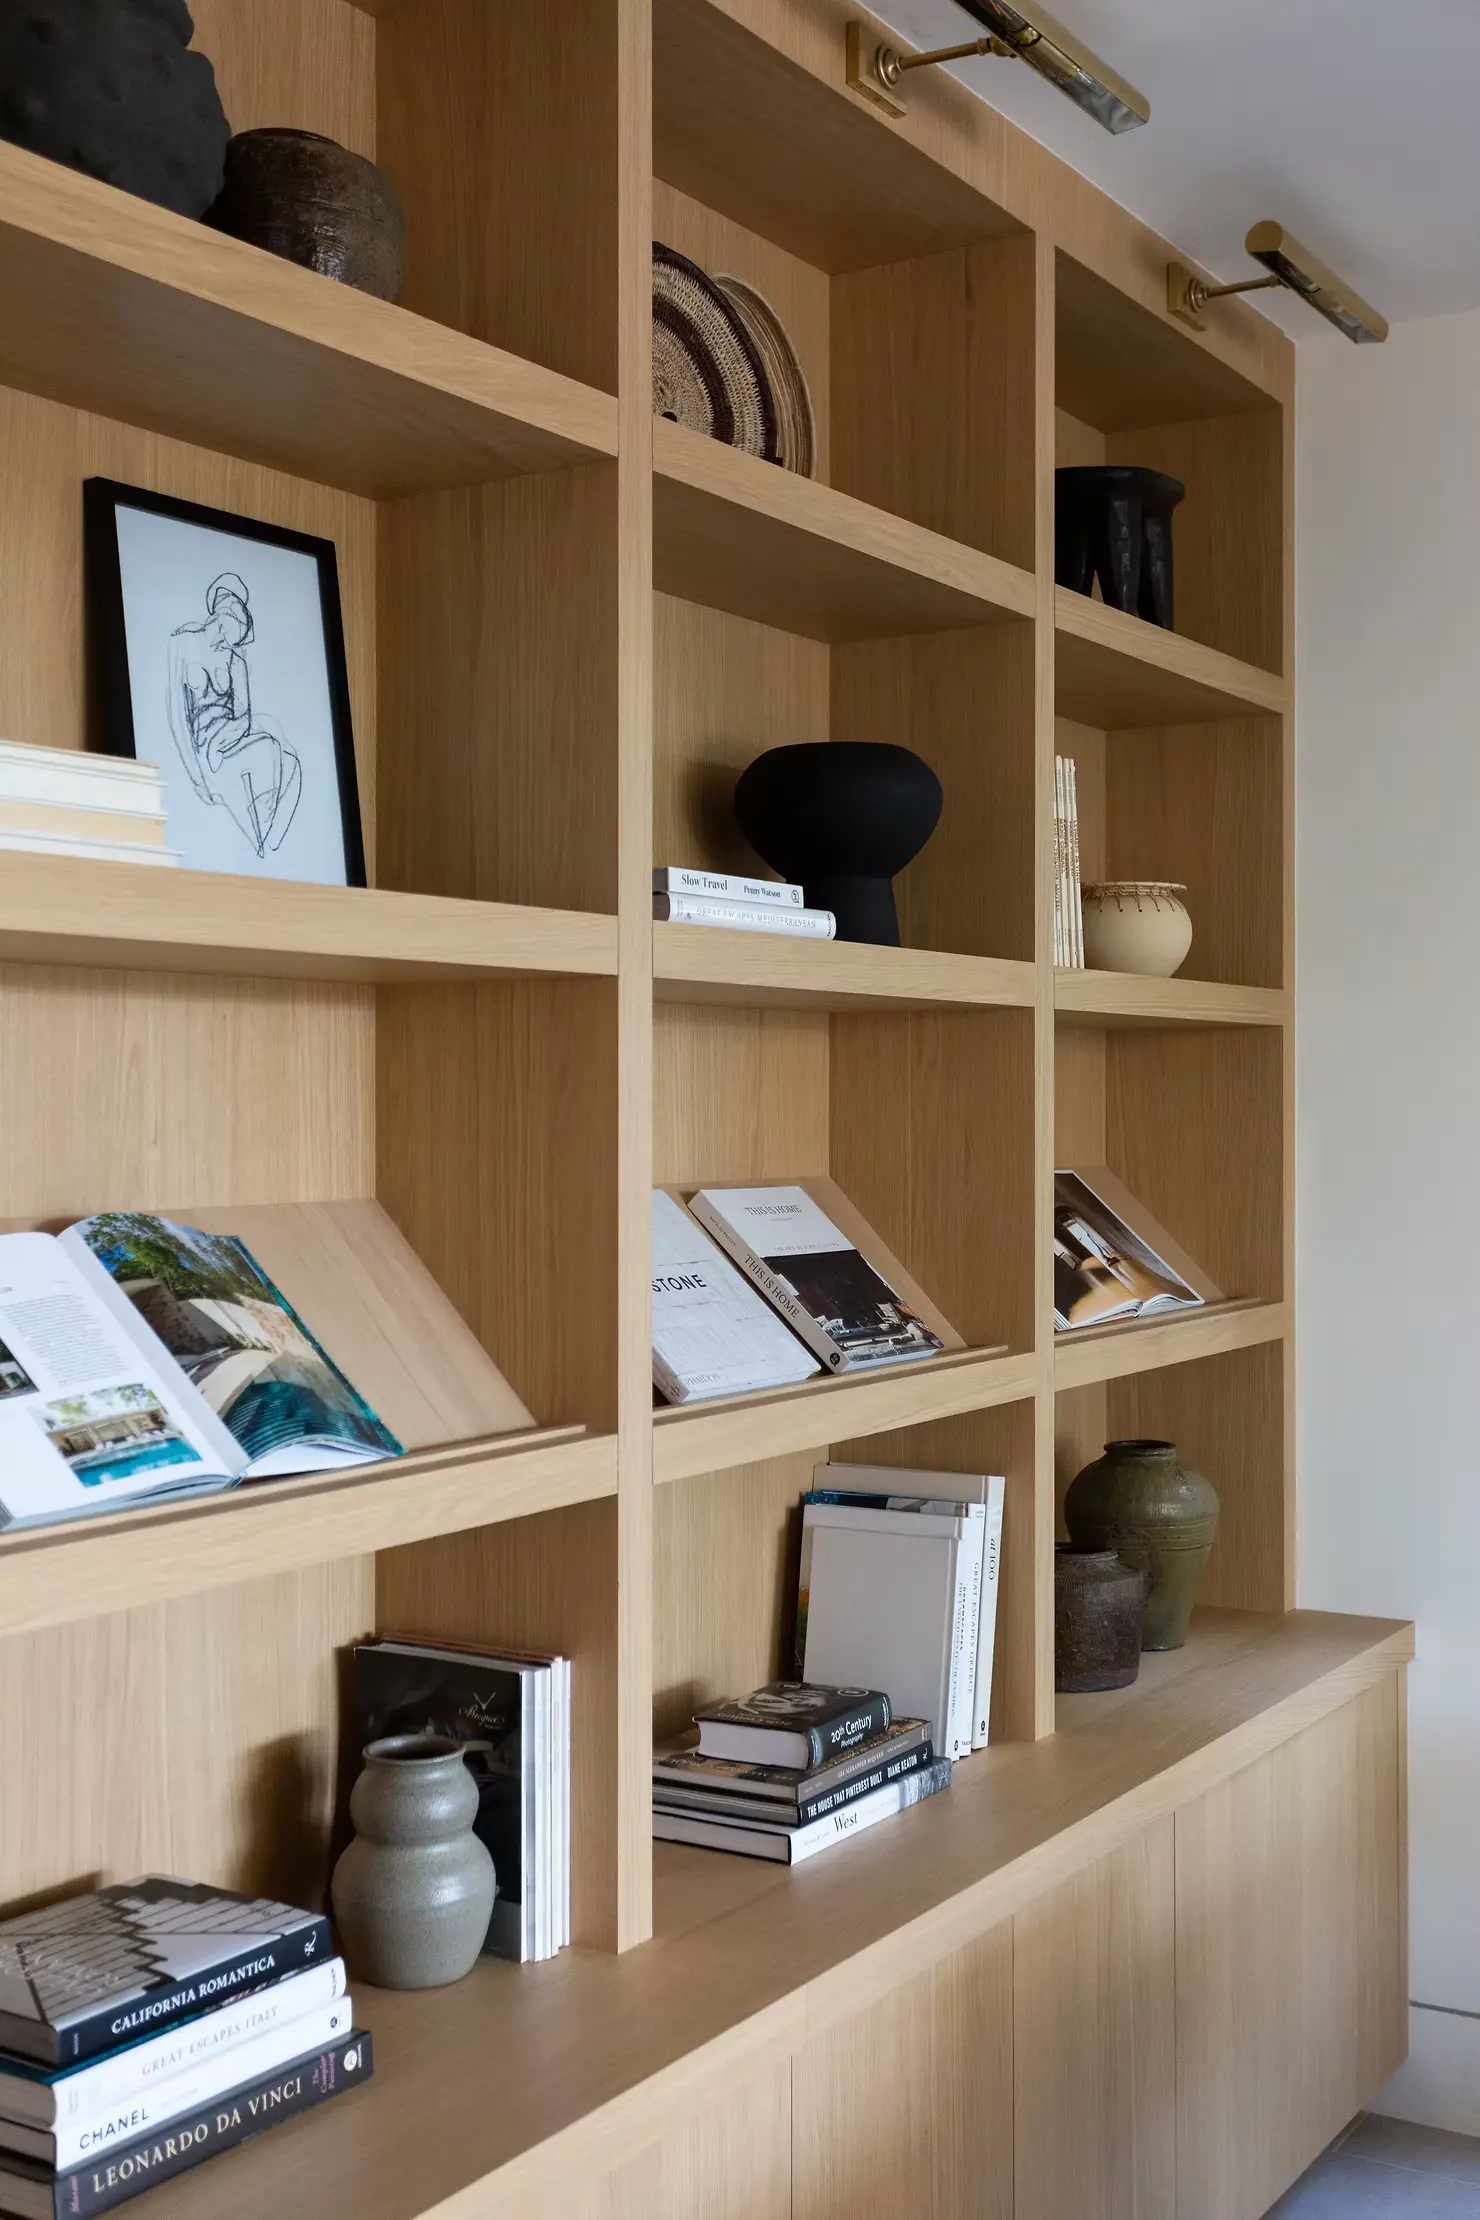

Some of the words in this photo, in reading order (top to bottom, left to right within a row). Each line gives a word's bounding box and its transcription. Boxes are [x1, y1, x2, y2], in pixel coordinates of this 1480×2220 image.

[682, 874, 700, 886] Slow
[702, 877, 728, 890] Travel
[744, 885, 760, 897] Penny
[761, 886, 781, 898] Watson
[744, 1206, 764, 1216] THIS
[764, 1205, 774, 1214] IS
[775, 1204, 802, 1214] HOME
[652, 1274, 707, 1292] STONE
[744, 1254, 766, 1280] THIS
[763, 1276, 774, 1289] IS
[772, 1286, 800, 1318] HOME
[831, 1726, 845, 1744] 20th
[845, 1714, 872, 1736] Century
[840, 1732, 864, 1748] Photography
[887, 1763, 900, 1778] DIANE
[900, 1754, 918, 1772] KEATON
[807, 1806, 817, 1818] THE
[818, 1799, 833, 1814] HOUSE
[834, 1792, 845, 1806] THAT
[846, 1778, 870, 1800] PINTEREST
[870, 1772, 882, 1788] BUILT
[834, 1812, 858, 1832] West
[111, 1988, 196, 2034] CALIFORNIA
[199, 1954, 276, 1998] ROMANTICA
[142, 2047, 183, 2076] GREAT
[189, 2023, 241, 2055] ESCAPES
[246, 2005, 278, 2028] ITALY
[79, 2108, 150, 2150] CHANEL
[92, 2123, 209, 2193] LEONARDO
[216, 2107, 242, 2134] DA
[248, 2076, 302, 2116] VINCI
